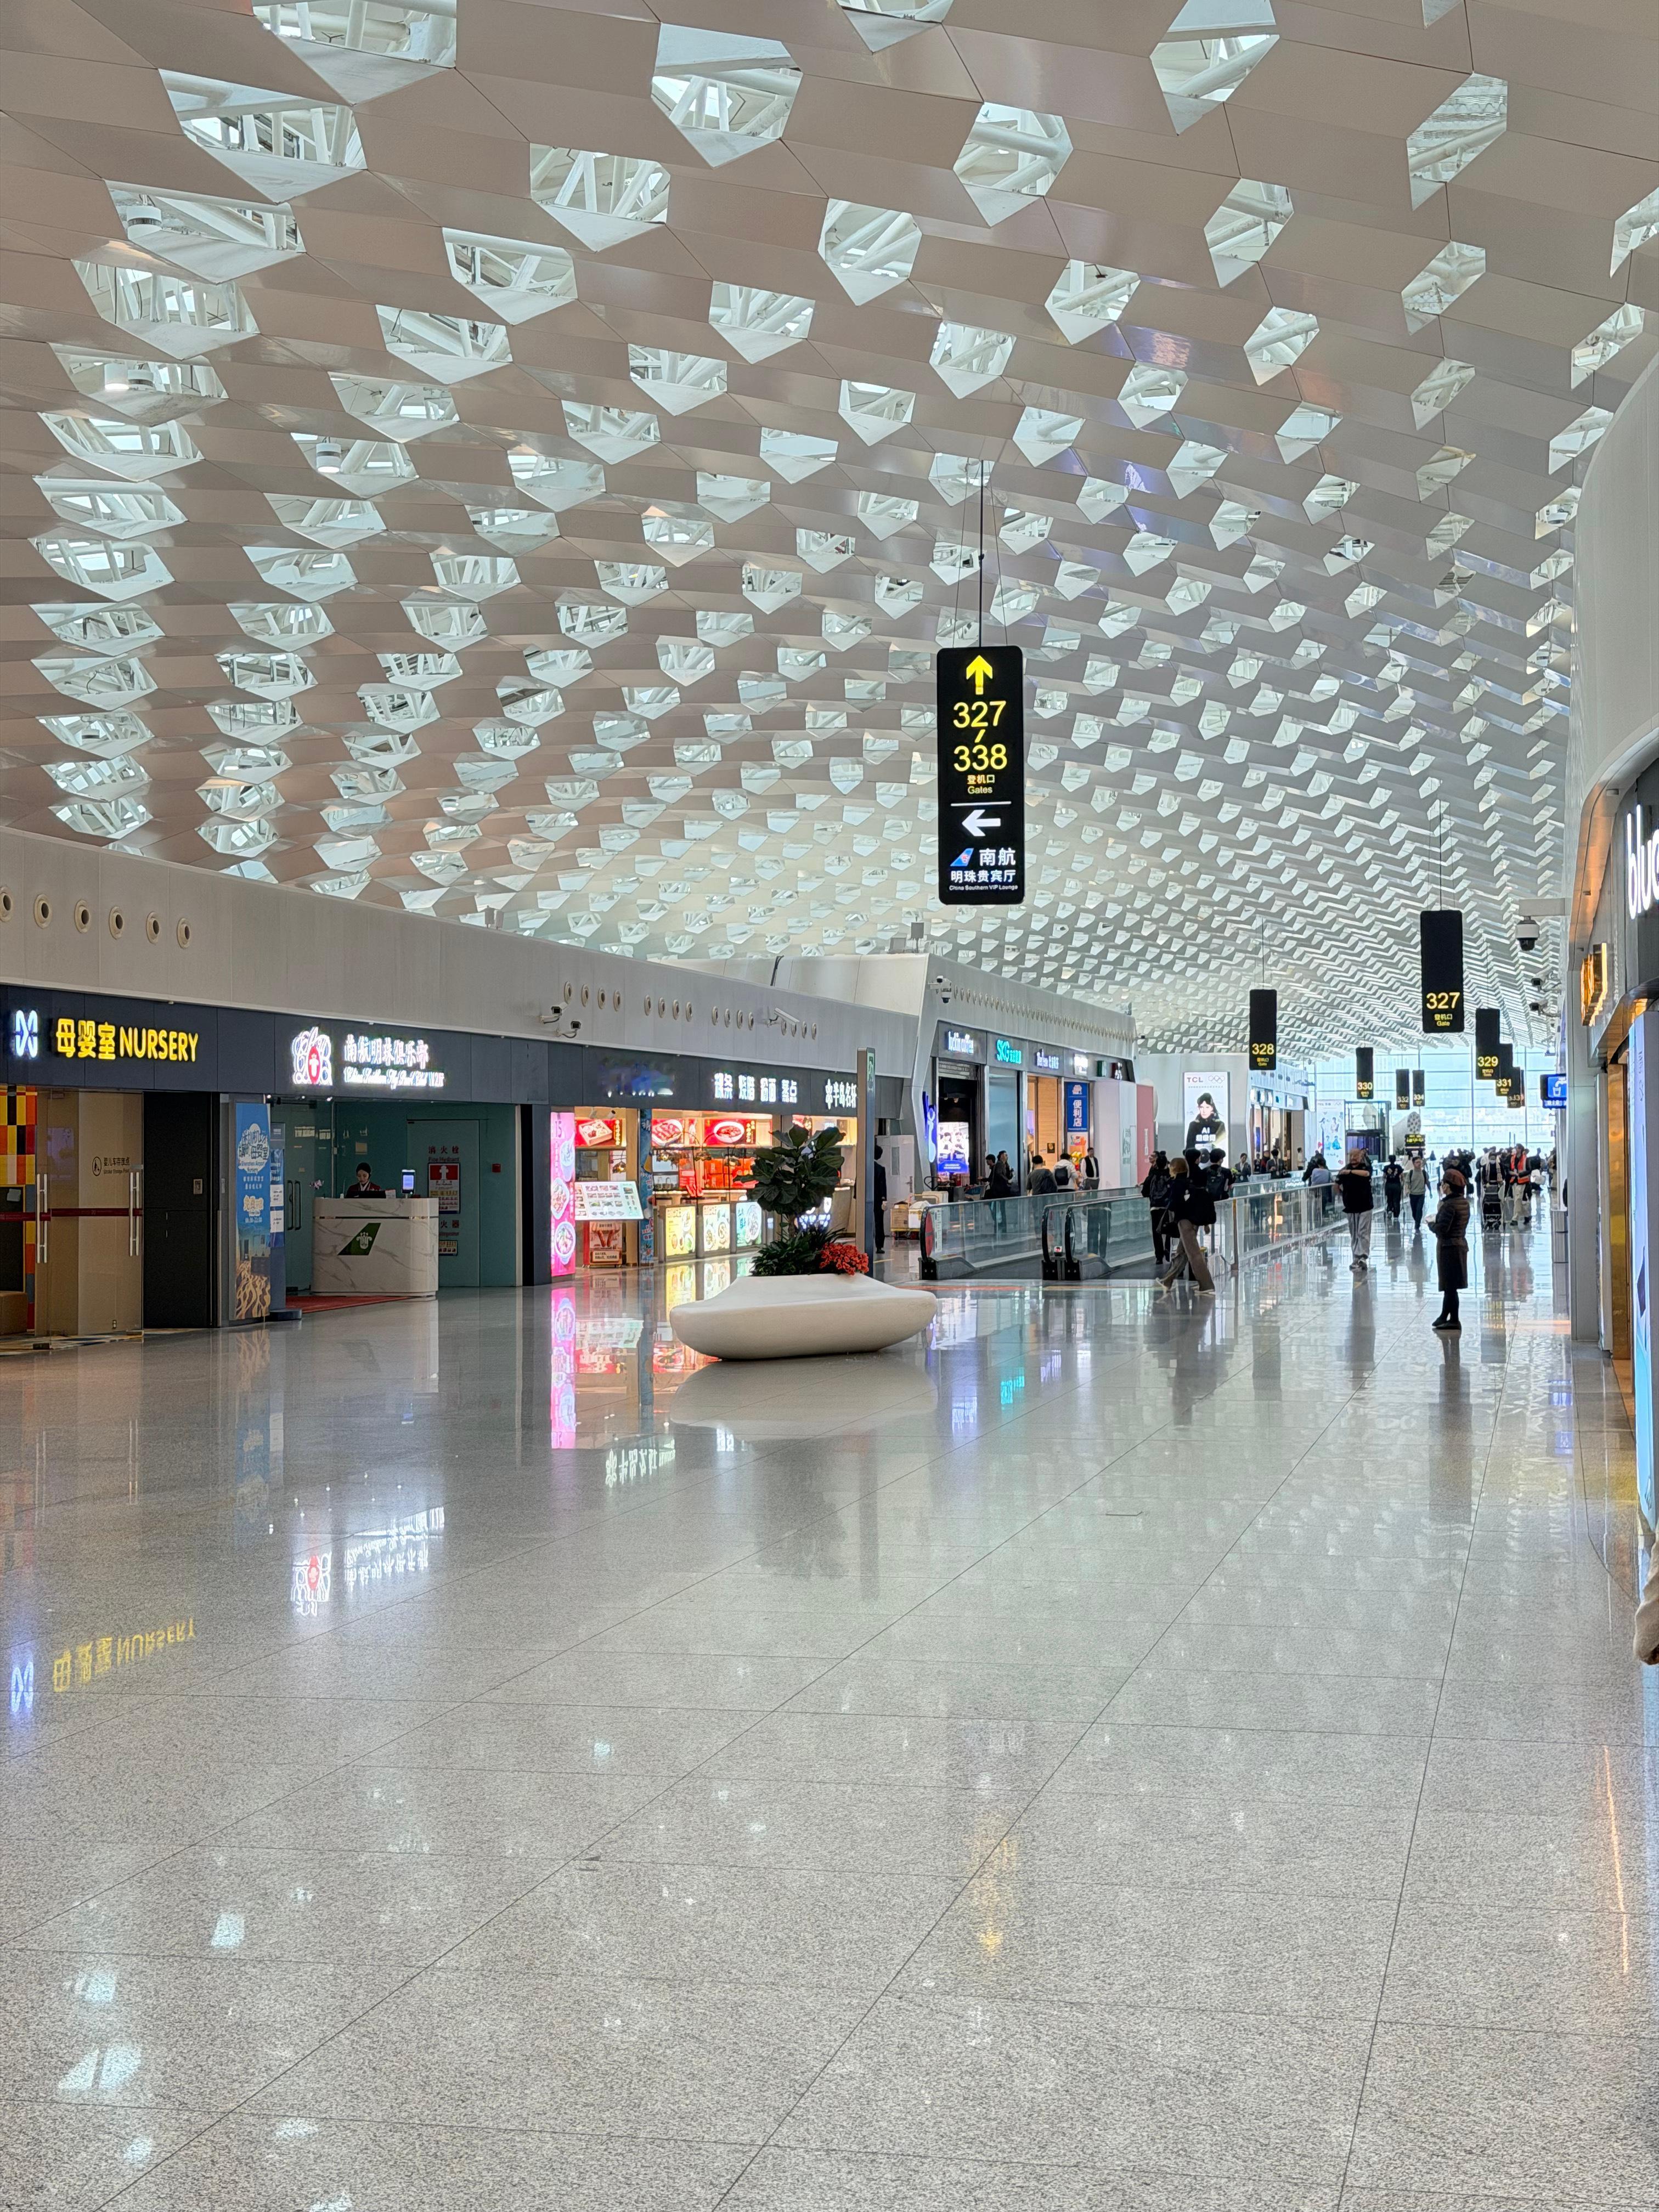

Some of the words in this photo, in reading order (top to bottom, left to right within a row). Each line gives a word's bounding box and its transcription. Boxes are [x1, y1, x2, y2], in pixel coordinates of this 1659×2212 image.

[953, 701, 1007, 728] 327
[953, 744, 1007, 771] 338
[967, 774, 995, 785] 登机口
[979, 848, 1016, 866] 南航
[951, 870, 1016, 883] 明珠贵宾厅
[1426, 992, 1460, 1009] 327
[56, 1018, 115, 1059] 母婴室
[120, 1026, 199, 1062] NURSERY
[344, 1034, 429, 1070] 南航明珠俱乐部
[996, 1039, 1010, 1063] SKG
[1252, 1043, 1274, 1055] 328
[1477, 1056, 1498, 1067] 329
[1357, 1082, 1373, 1091] 330
[1497, 1079, 1511, 1087] 331
[1073, 1099, 1082, 1127] 便利店
[427, 1146, 459, 1154] 消火栓
